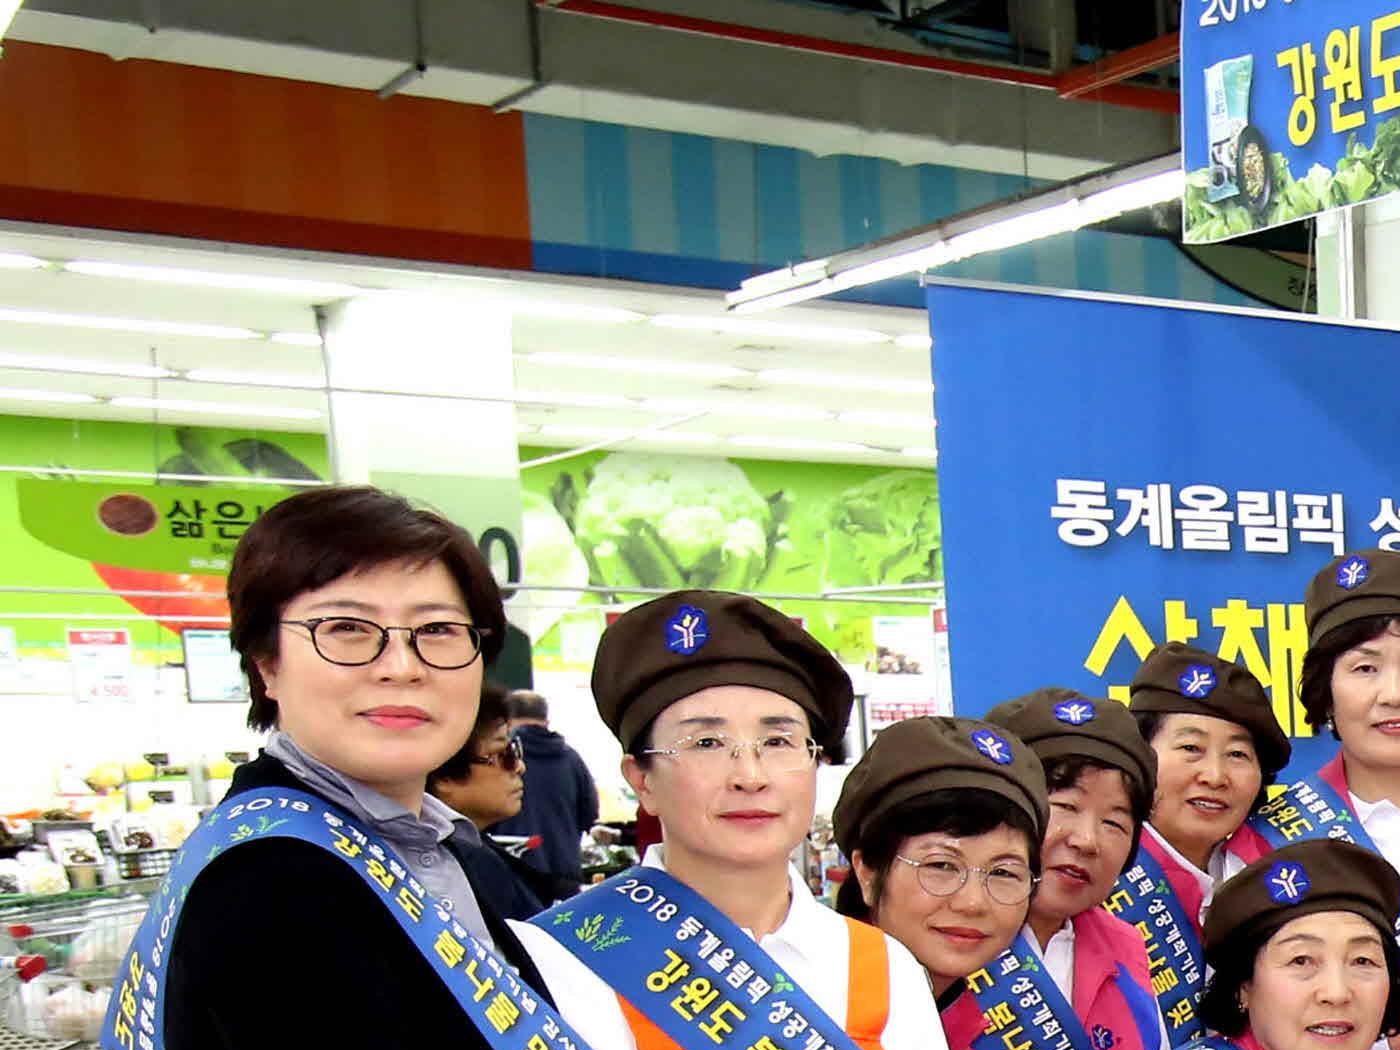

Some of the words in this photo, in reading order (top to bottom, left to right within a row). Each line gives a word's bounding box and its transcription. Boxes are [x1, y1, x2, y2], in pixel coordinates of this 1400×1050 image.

[166, 497, 264, 540] 삶은
[1050, 478, 1346, 556] 동계올림픽
[229, 797, 311, 821] 2018
[1257, 795, 1315, 842] 강원도
[1288, 780, 1337, 824] 계올림픽
[615, 878, 678, 922] 2018
[674, 914, 772, 1006] 동계올림픽
[1147, 898, 1201, 986] 성공개최기념
[432, 928, 522, 1035] 봄나물
[644, 948, 747, 1045] 강원도
[1166, 1003, 1195, 1030] 및
